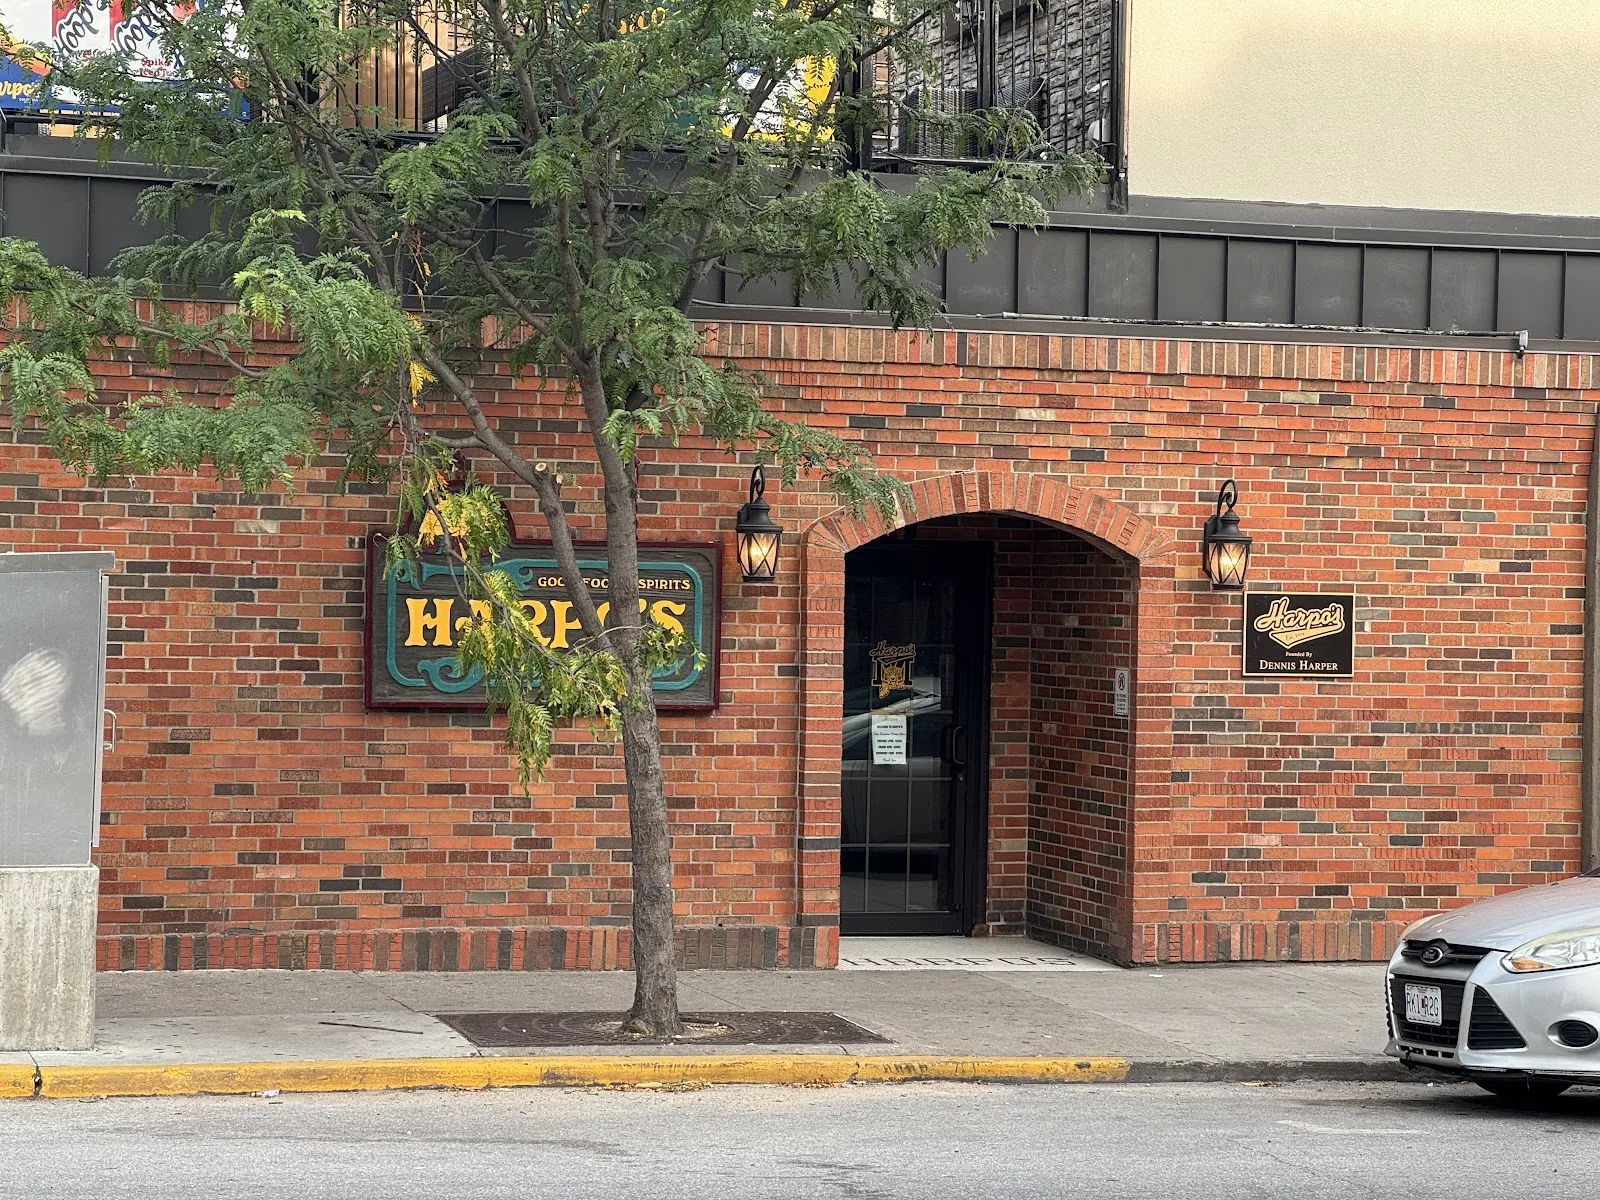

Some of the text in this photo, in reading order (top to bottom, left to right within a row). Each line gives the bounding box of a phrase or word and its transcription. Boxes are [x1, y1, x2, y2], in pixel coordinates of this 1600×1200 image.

[537, 577, 691, 590] GOO FOO SPIRITS
[1254, 597, 1344, 631] Harpo's
[869, 640, 916, 657] Harpo's
[1305, 651, 1313, 659] By
[1259, 660, 1339, 671] DENNIS HARPER
